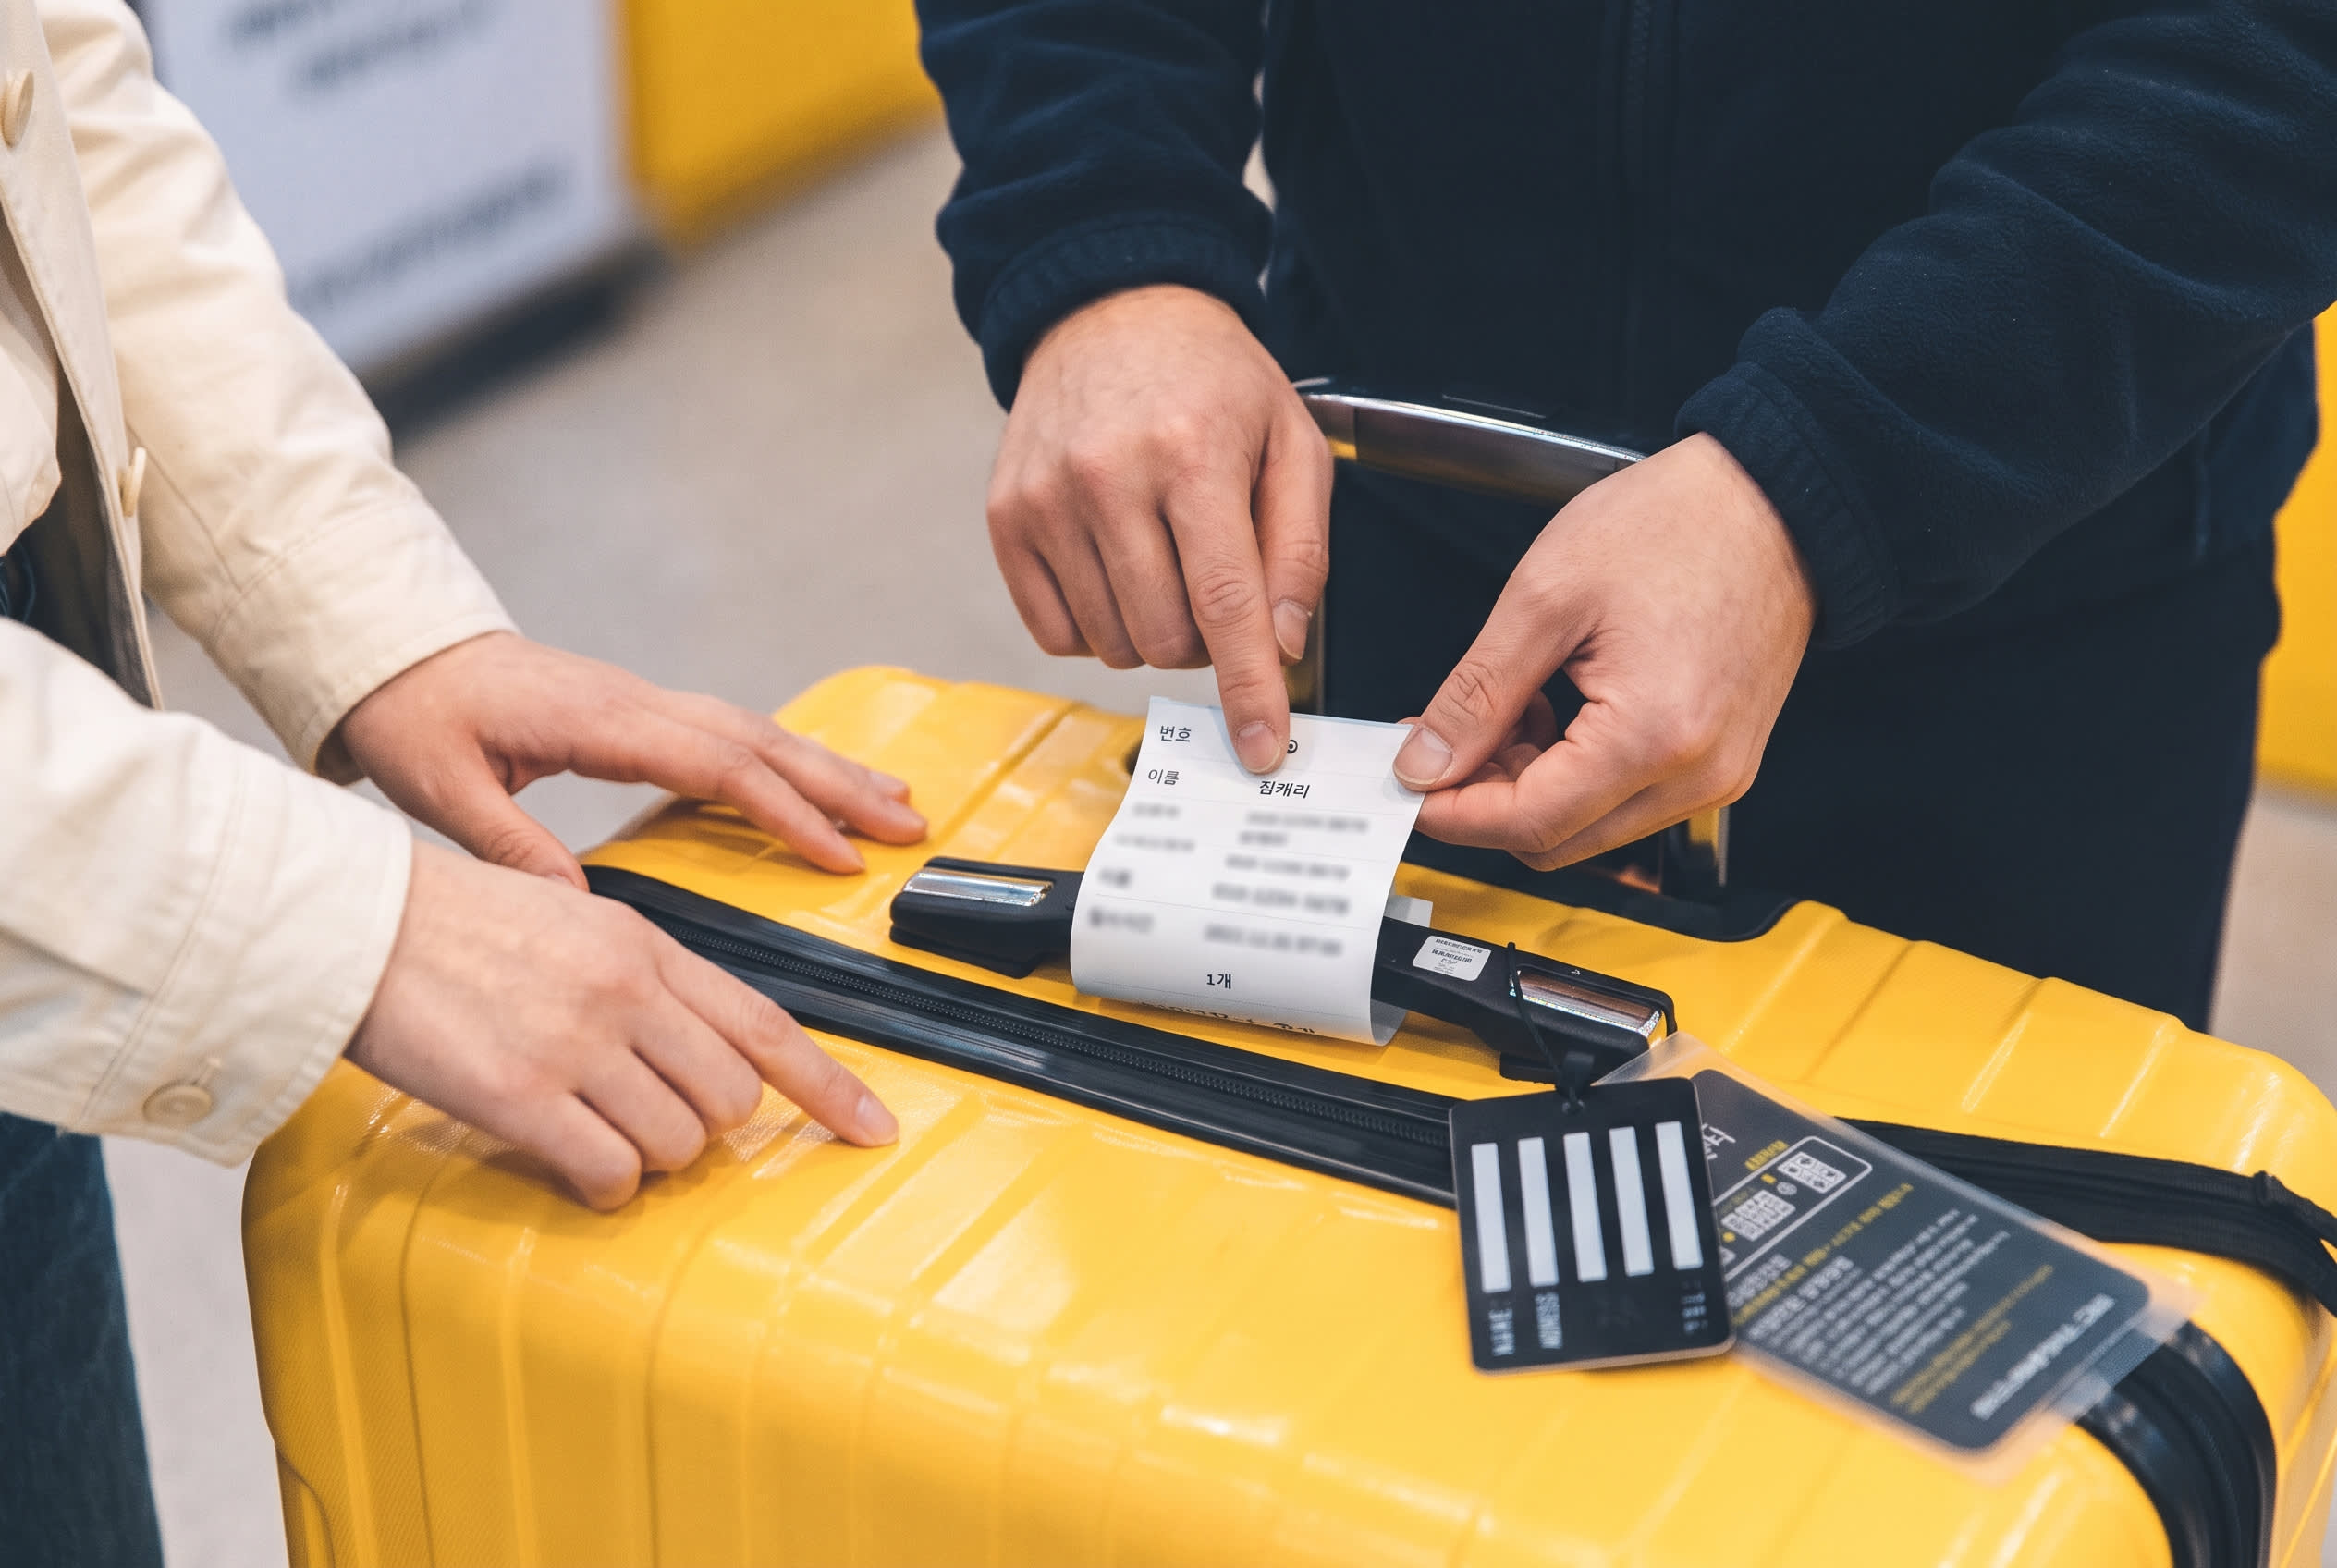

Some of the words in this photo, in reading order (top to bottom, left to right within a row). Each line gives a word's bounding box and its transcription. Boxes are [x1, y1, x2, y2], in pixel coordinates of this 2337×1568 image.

[1160, 725, 1192, 742] 번호
[1148, 768, 1180, 786] 이름
[1259, 780, 1310, 799] 짐캐리
[1206, 974, 1231, 989] 1개
